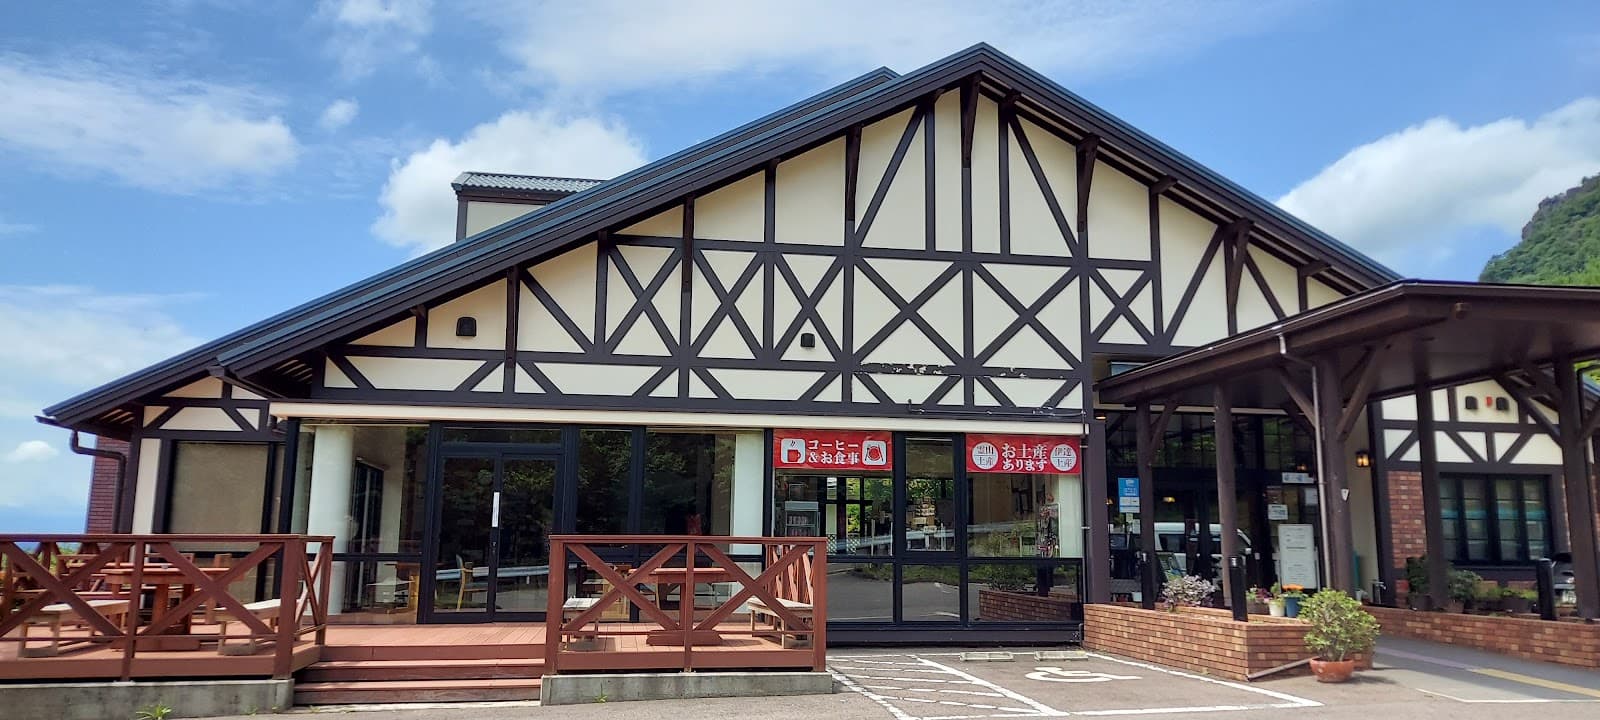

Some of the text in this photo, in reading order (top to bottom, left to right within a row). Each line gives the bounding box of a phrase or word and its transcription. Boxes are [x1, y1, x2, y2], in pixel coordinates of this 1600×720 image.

[808, 440, 859, 450] コーヒー
[1002, 443, 1048, 460] お土産
[808, 451, 860, 465] &お食事
[1002, 459, 1048, 472] あります
